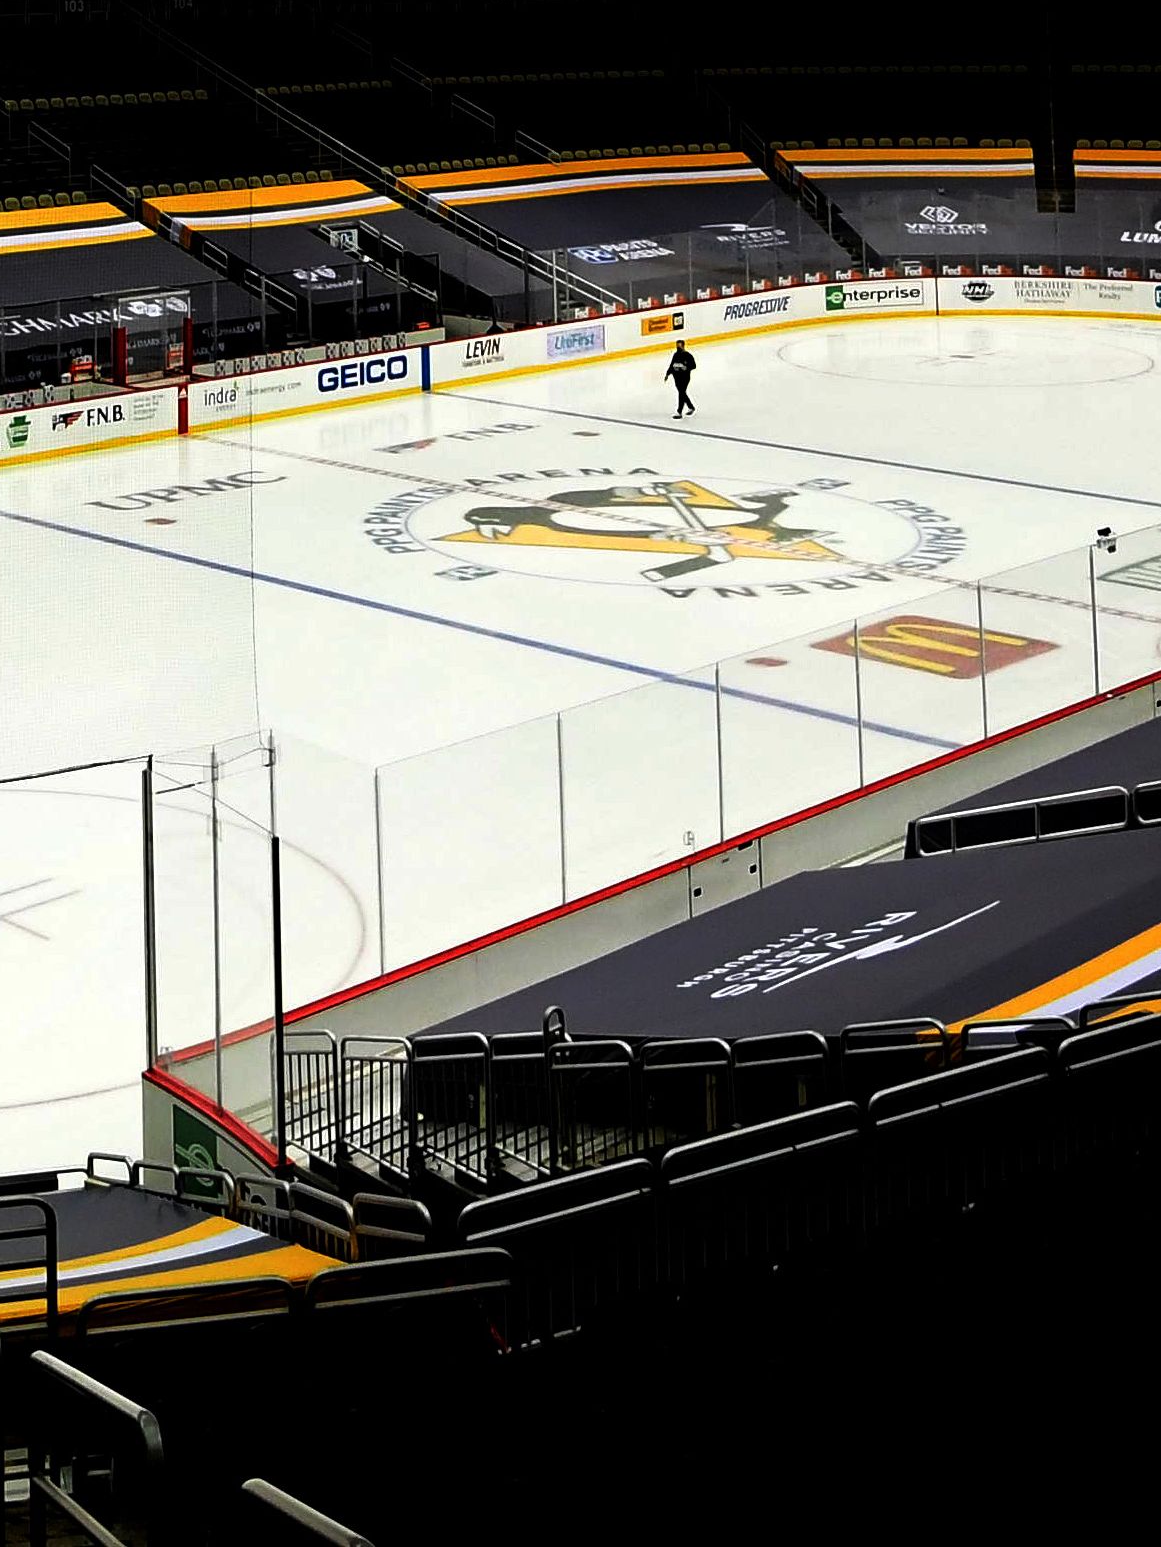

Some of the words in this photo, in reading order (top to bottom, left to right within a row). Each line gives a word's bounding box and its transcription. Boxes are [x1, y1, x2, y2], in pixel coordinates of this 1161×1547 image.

[826, 285, 921, 305] enterprise
[1014, 280, 1074, 289] BERKSHIRE
[1016, 289, 1072, 298] HATHAWAY
[724, 296, 791, 321] PROGRESSIVE
[466, 337, 501, 360] LEVIN
[318, 354, 408, 393] GEICO
[204, 389, 237, 407] indra
[86, 404, 126, 428] F.N.B.
[463, 466, 660, 488] ARENA
[85, 470, 287, 512] UPMC
[364, 485, 457, 526] PAINTS
[876, 499, 951, 524] PPG
[365, 527, 427, 555] PPG
[897, 526, 968, 572] PAINTS
[660, 570, 894, 599] ARENA
[710, 911, 917, 999] RIVERS
[724, 932, 837, 982] CASINO
